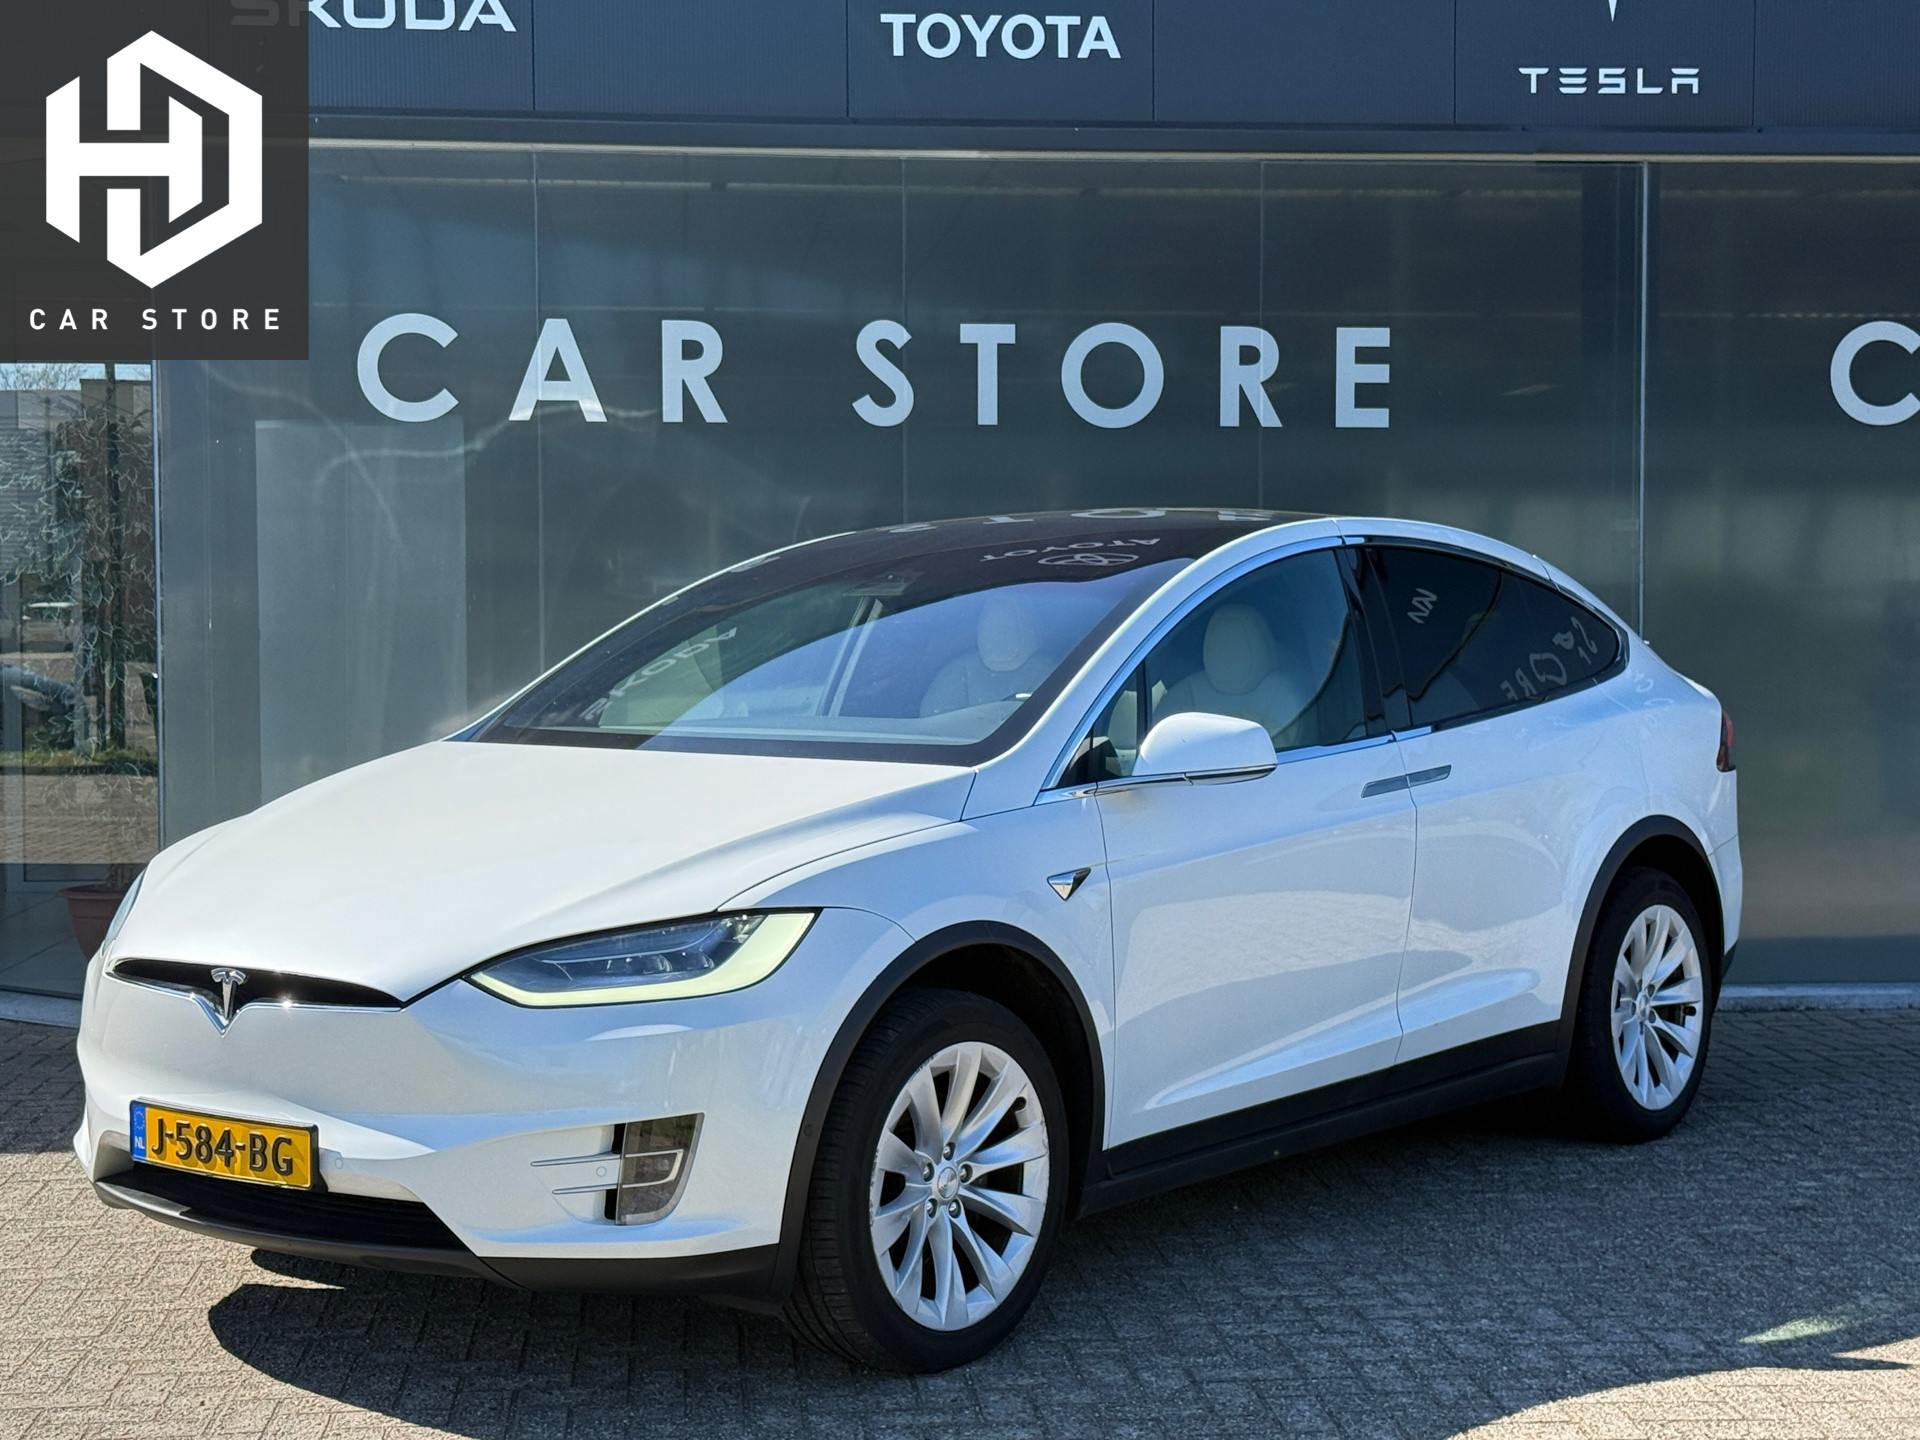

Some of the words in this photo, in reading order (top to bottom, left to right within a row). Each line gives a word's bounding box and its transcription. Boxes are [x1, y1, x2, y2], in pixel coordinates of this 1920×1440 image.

[880, 13, 1121, 59] TOYOTA
[1518, 67, 1700, 95] TESLA
[357, 312, 728, 424] CAR
[852, 319, 1391, 429] STORE
[134, 1135, 145, 1150] NL
[151, 1116, 294, 1177] J-584-BG
